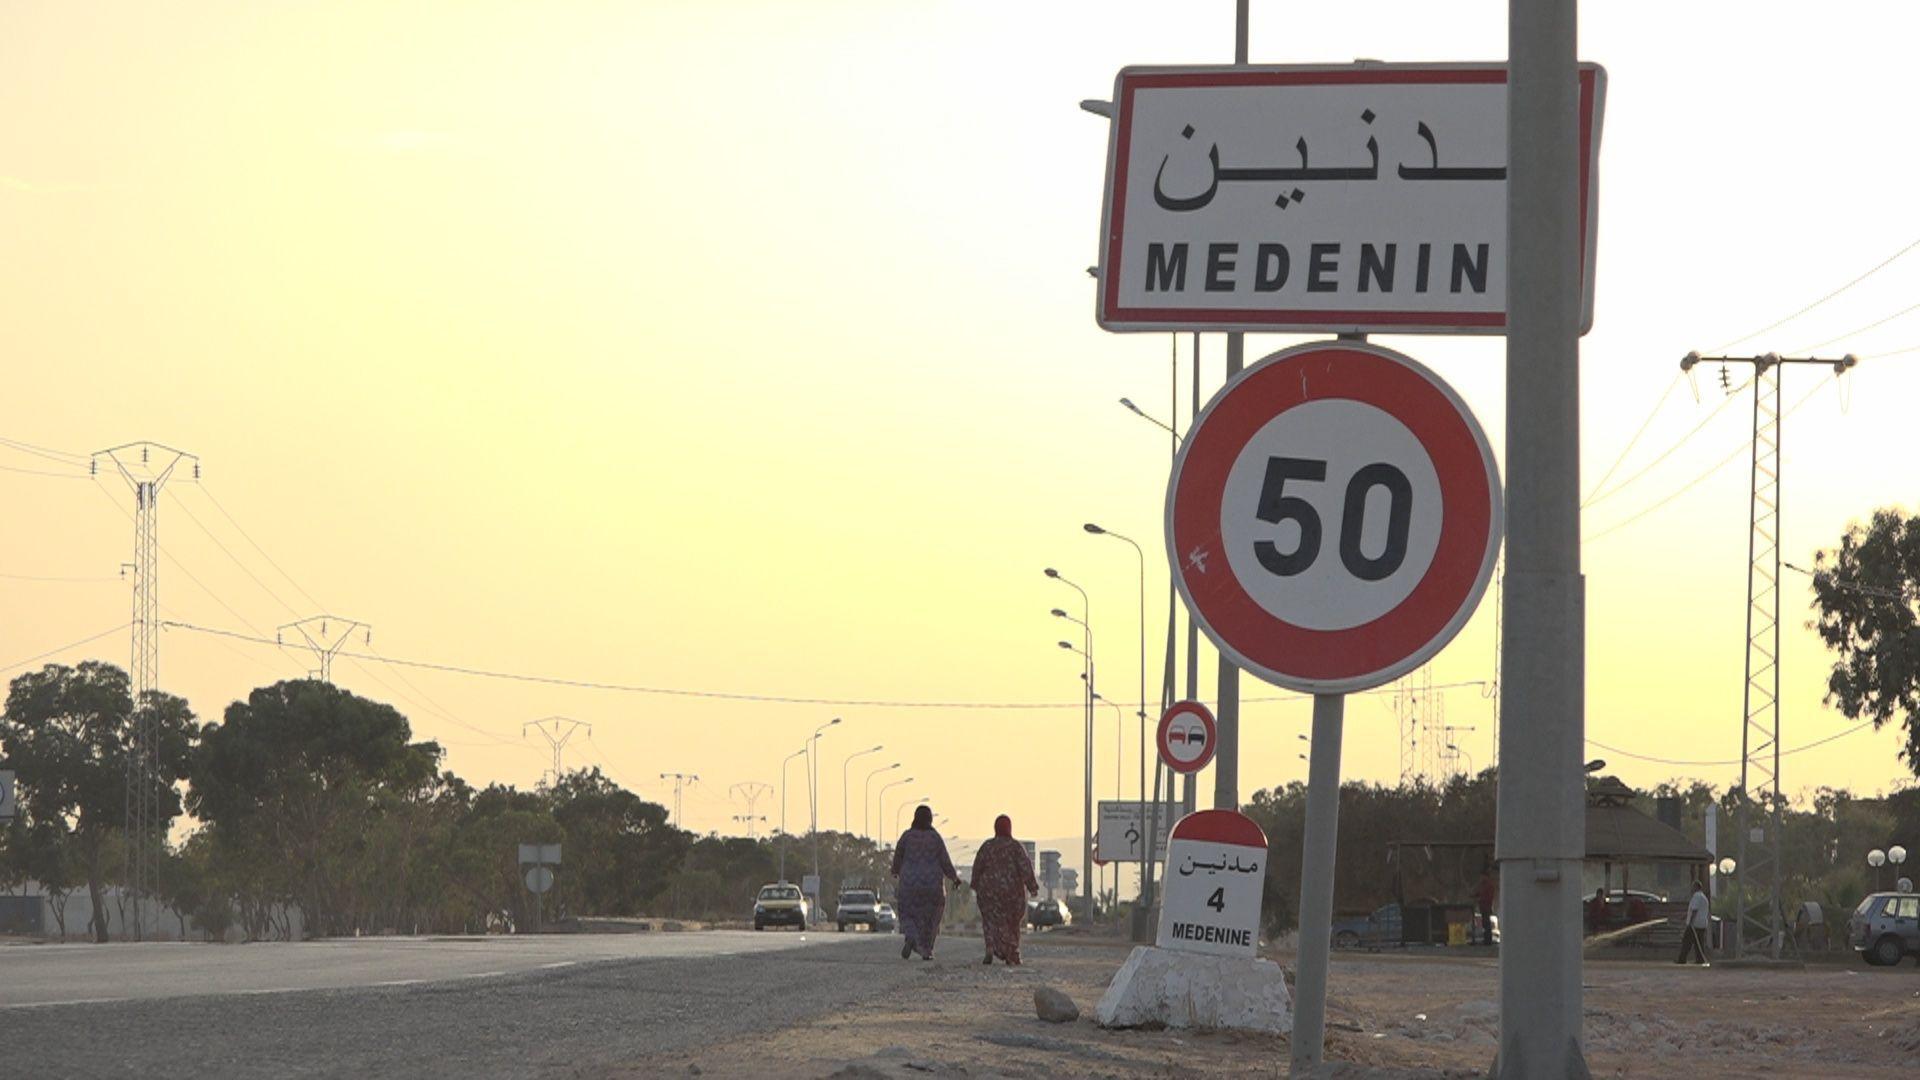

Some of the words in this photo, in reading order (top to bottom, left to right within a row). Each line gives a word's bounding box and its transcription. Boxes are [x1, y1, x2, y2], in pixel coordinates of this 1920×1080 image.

[1153, 108, 1507, 212] دنين
[1145, 242, 1490, 293] MEDENIN
[1253, 456, 1413, 582] 50
[1179, 853, 1258, 876] مدنين
[1206, 886, 1225, 913] 4
[1172, 922, 1252, 946] MEDENINE
